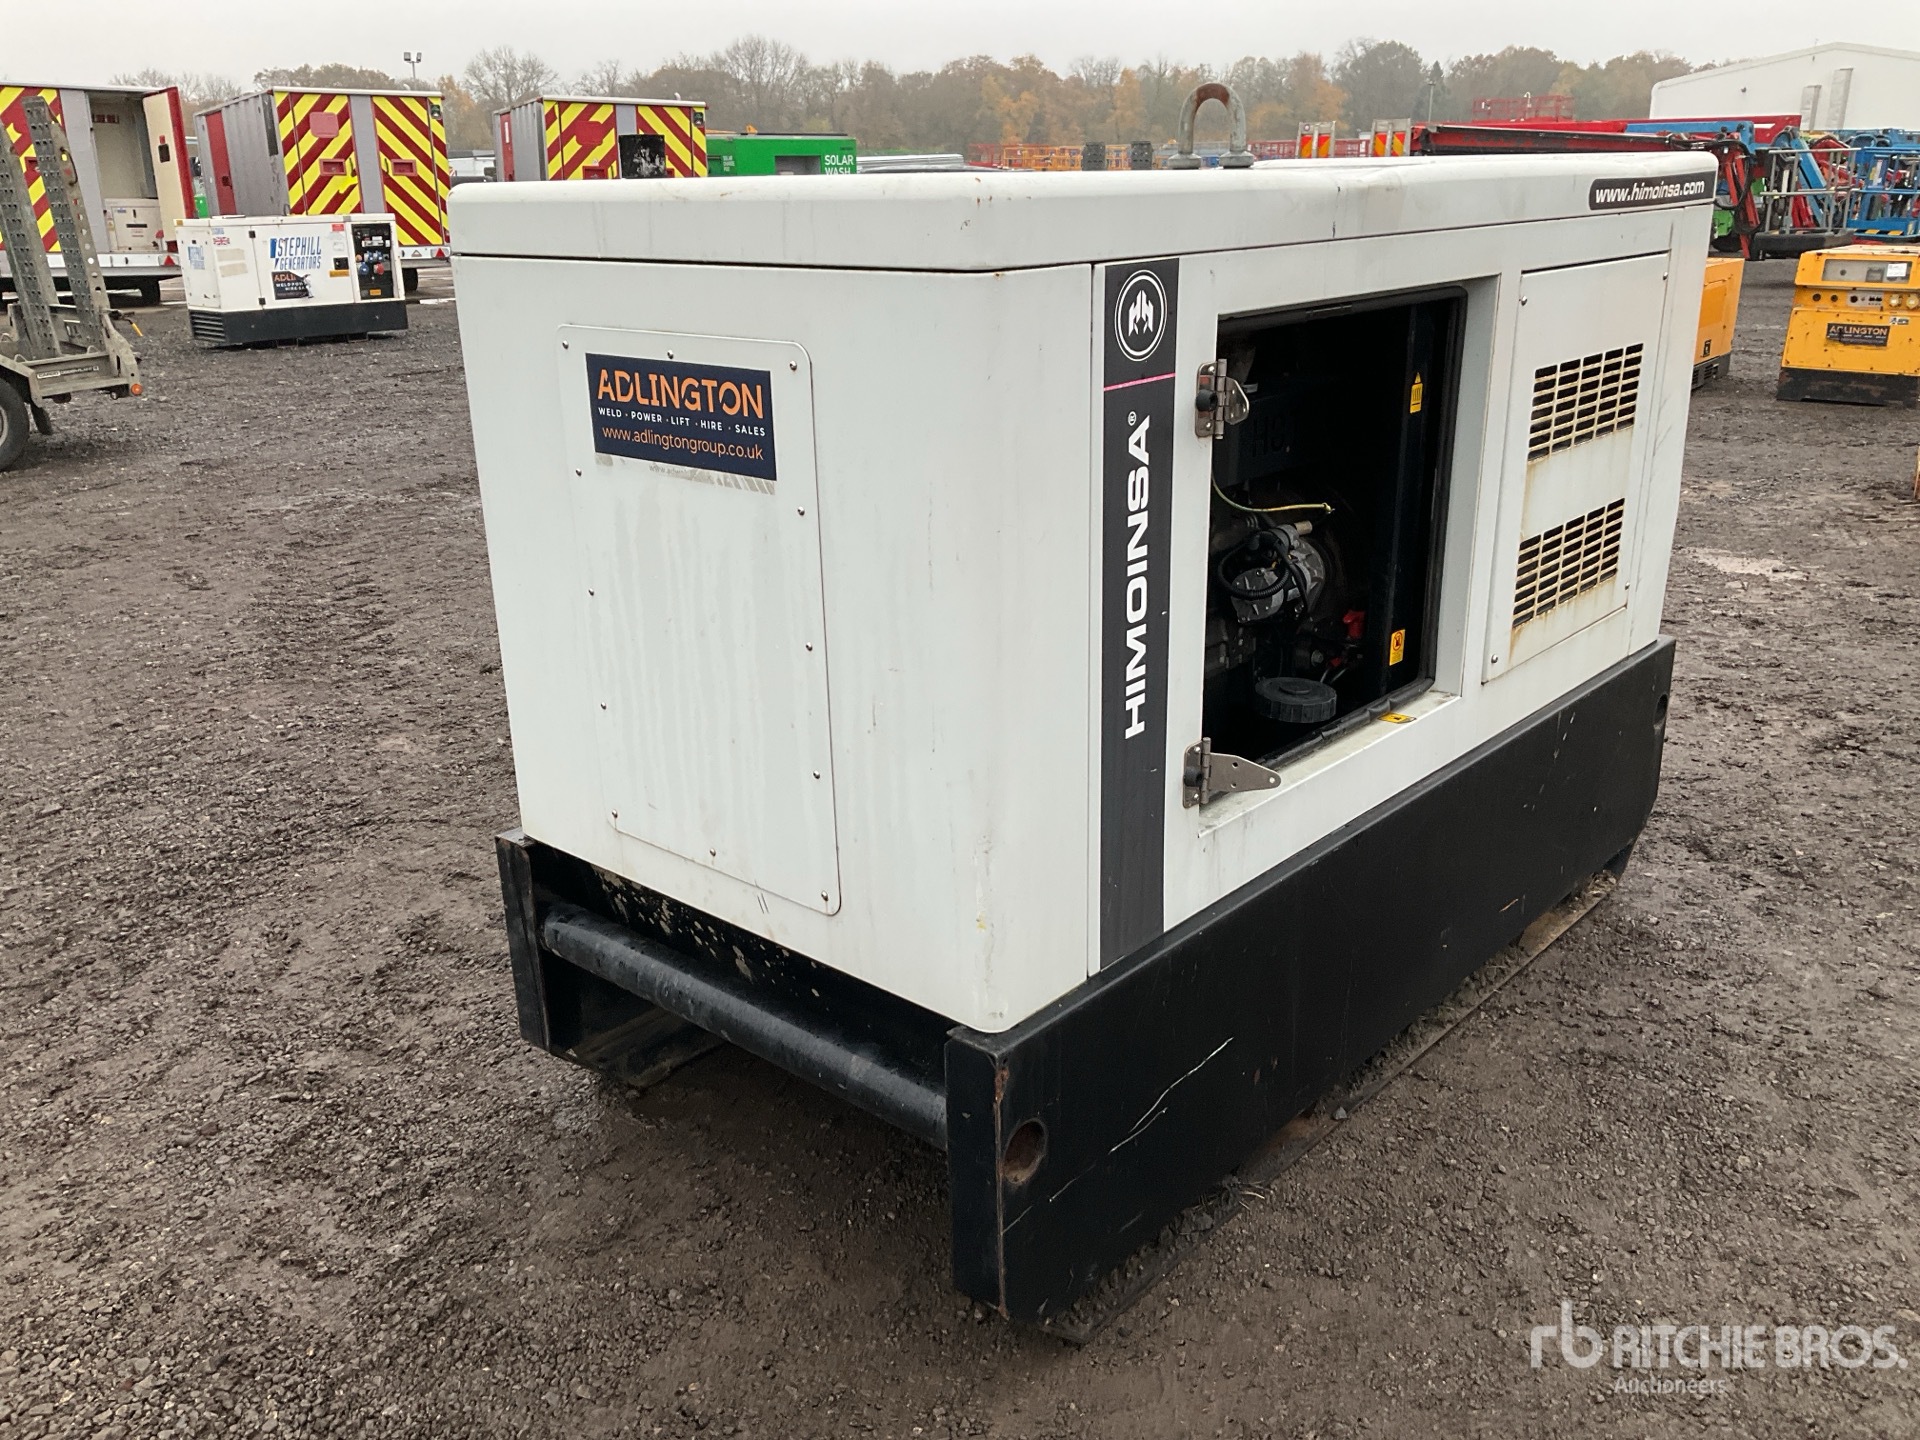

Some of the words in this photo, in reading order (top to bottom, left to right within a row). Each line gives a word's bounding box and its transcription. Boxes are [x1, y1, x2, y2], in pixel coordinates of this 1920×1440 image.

[824, 154, 854, 166] SOLAR
[1595, 181, 1705, 203] www.himoinsa.com
[278, 236, 322, 256] STEPHILL
[280, 256, 321, 270] GENERATORS
[598, 368, 764, 419] ADLINGTON
[598, 406, 622, 418] WELD
[631, 410, 662, 423] POWER
[670, 416, 690, 427] LIFT
[700, 419, 723, 431] HIRE
[735, 424, 766, 437] SALES
[602, 427, 764, 461] www.adlingtongroup.co.uk
